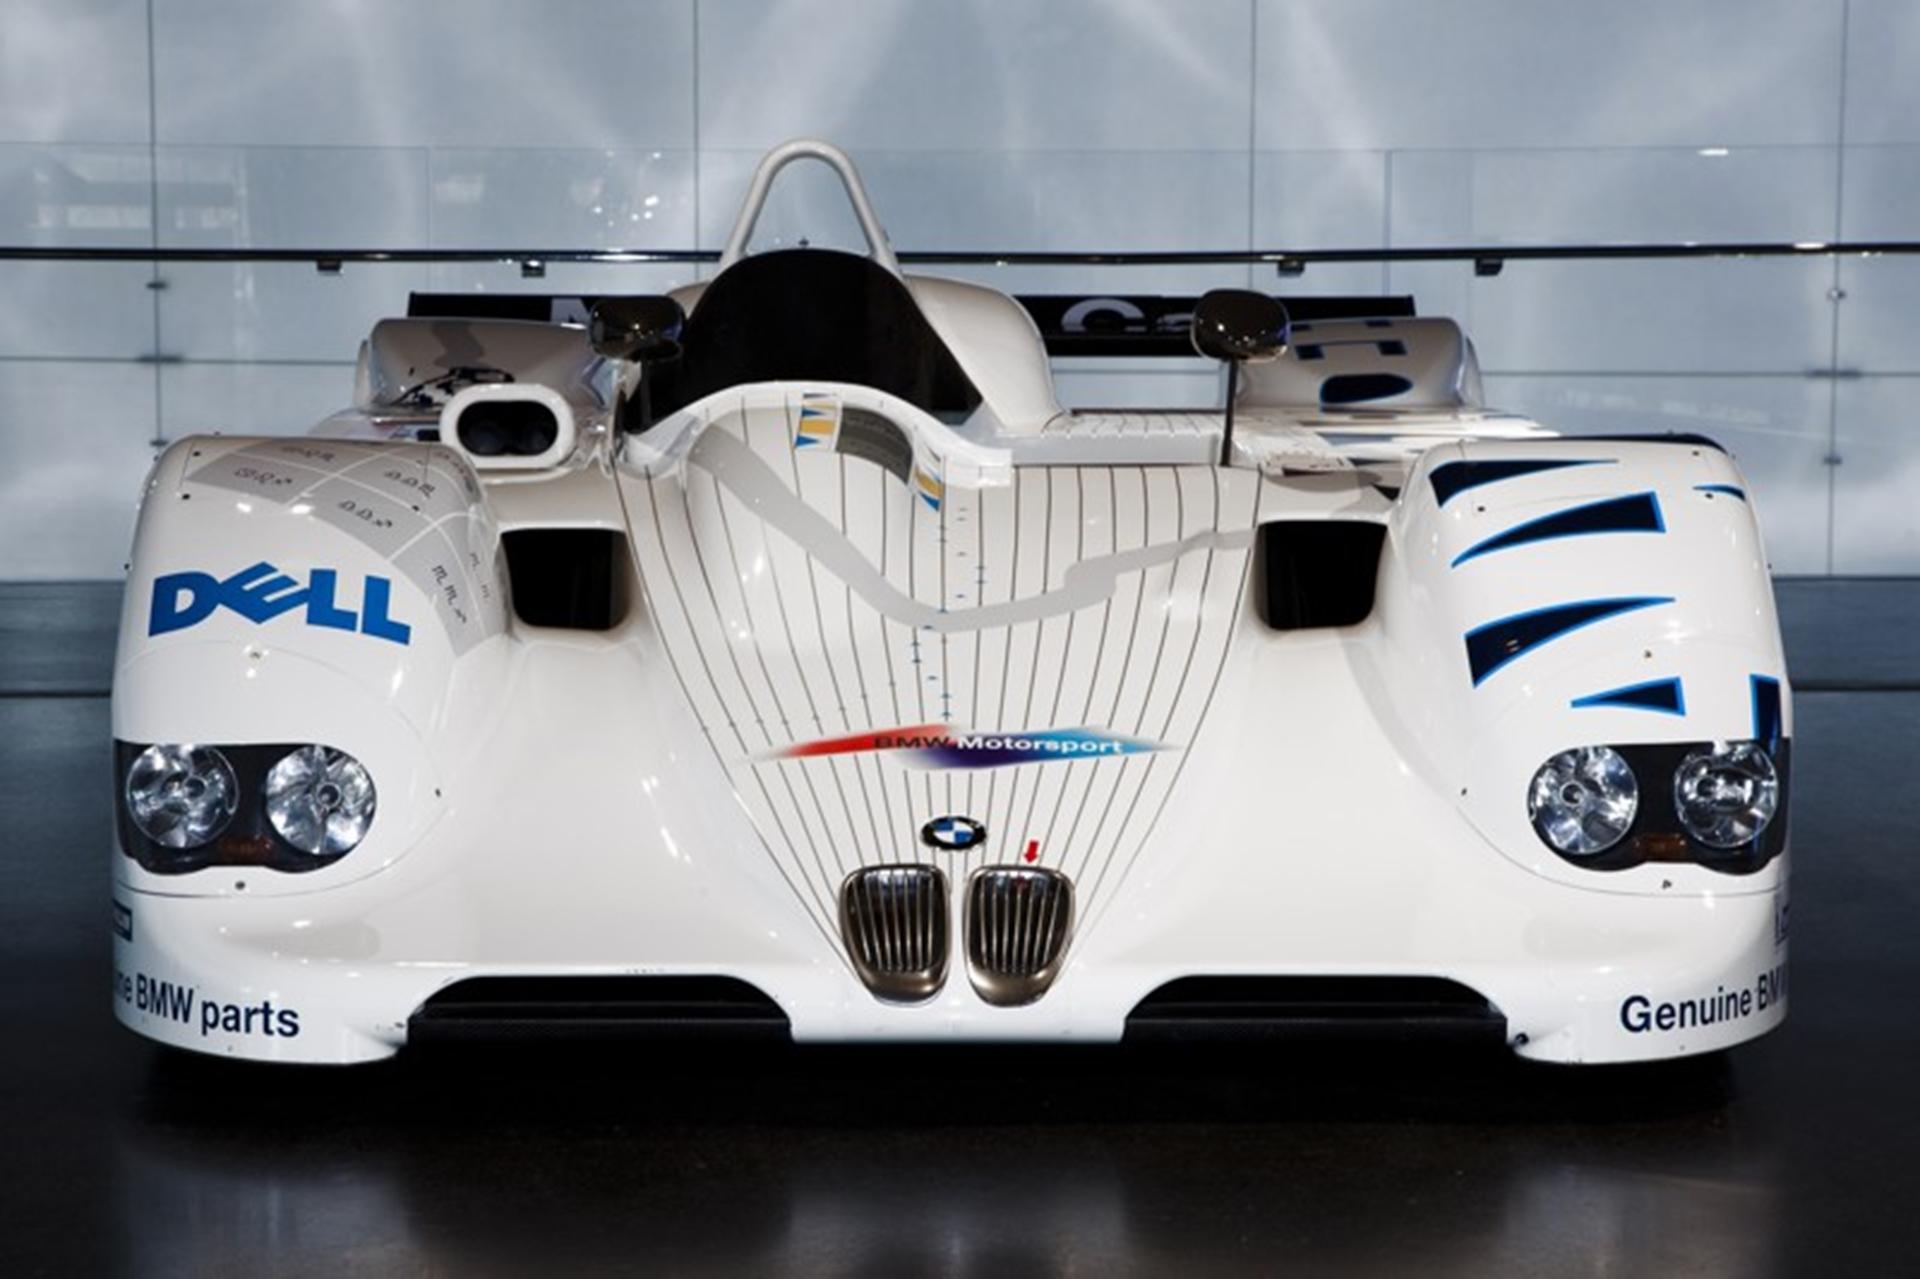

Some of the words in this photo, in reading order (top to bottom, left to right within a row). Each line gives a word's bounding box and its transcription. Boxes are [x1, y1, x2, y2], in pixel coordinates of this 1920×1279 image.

[148, 561, 411, 645] DELL
[873, 736, 949, 749] BMW
[956, 736, 1123, 753] Motorsport
[136, 973, 194, 1023] BMW
[202, 1000, 300, 1037] parts
[1621, 986, 1751, 1032] Genuine
